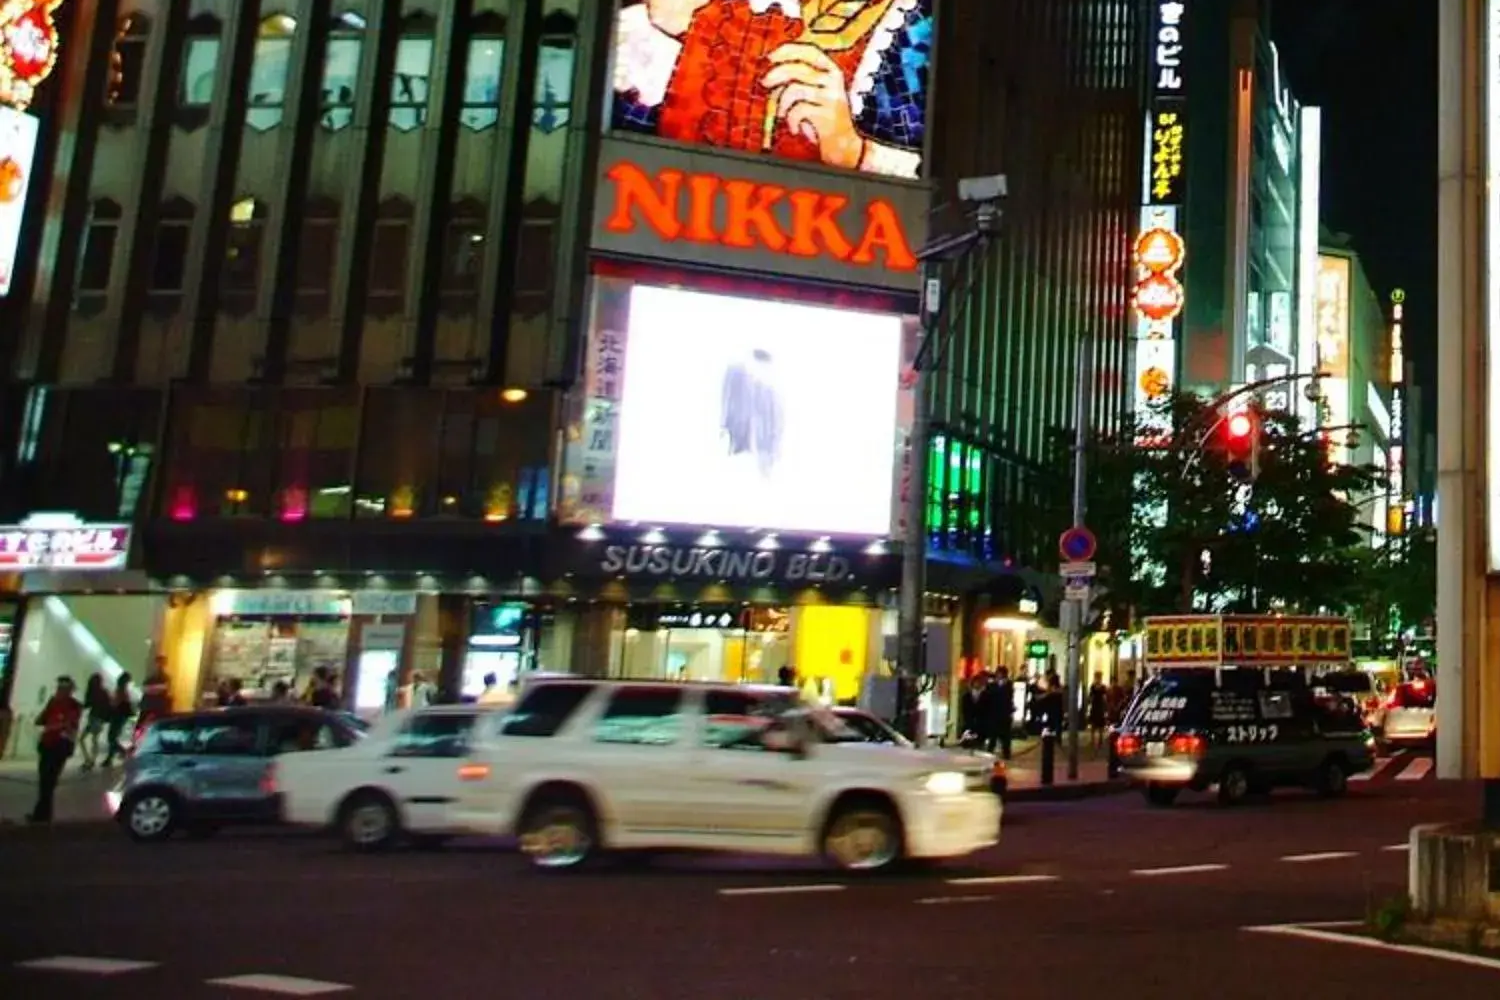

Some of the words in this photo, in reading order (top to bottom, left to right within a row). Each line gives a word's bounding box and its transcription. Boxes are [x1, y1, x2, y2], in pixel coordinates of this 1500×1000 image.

[604, 159, 920, 273] NIKKA
[601, 543, 775, 579] SUSUKINO
[785, 551, 855, 581] BLD.
